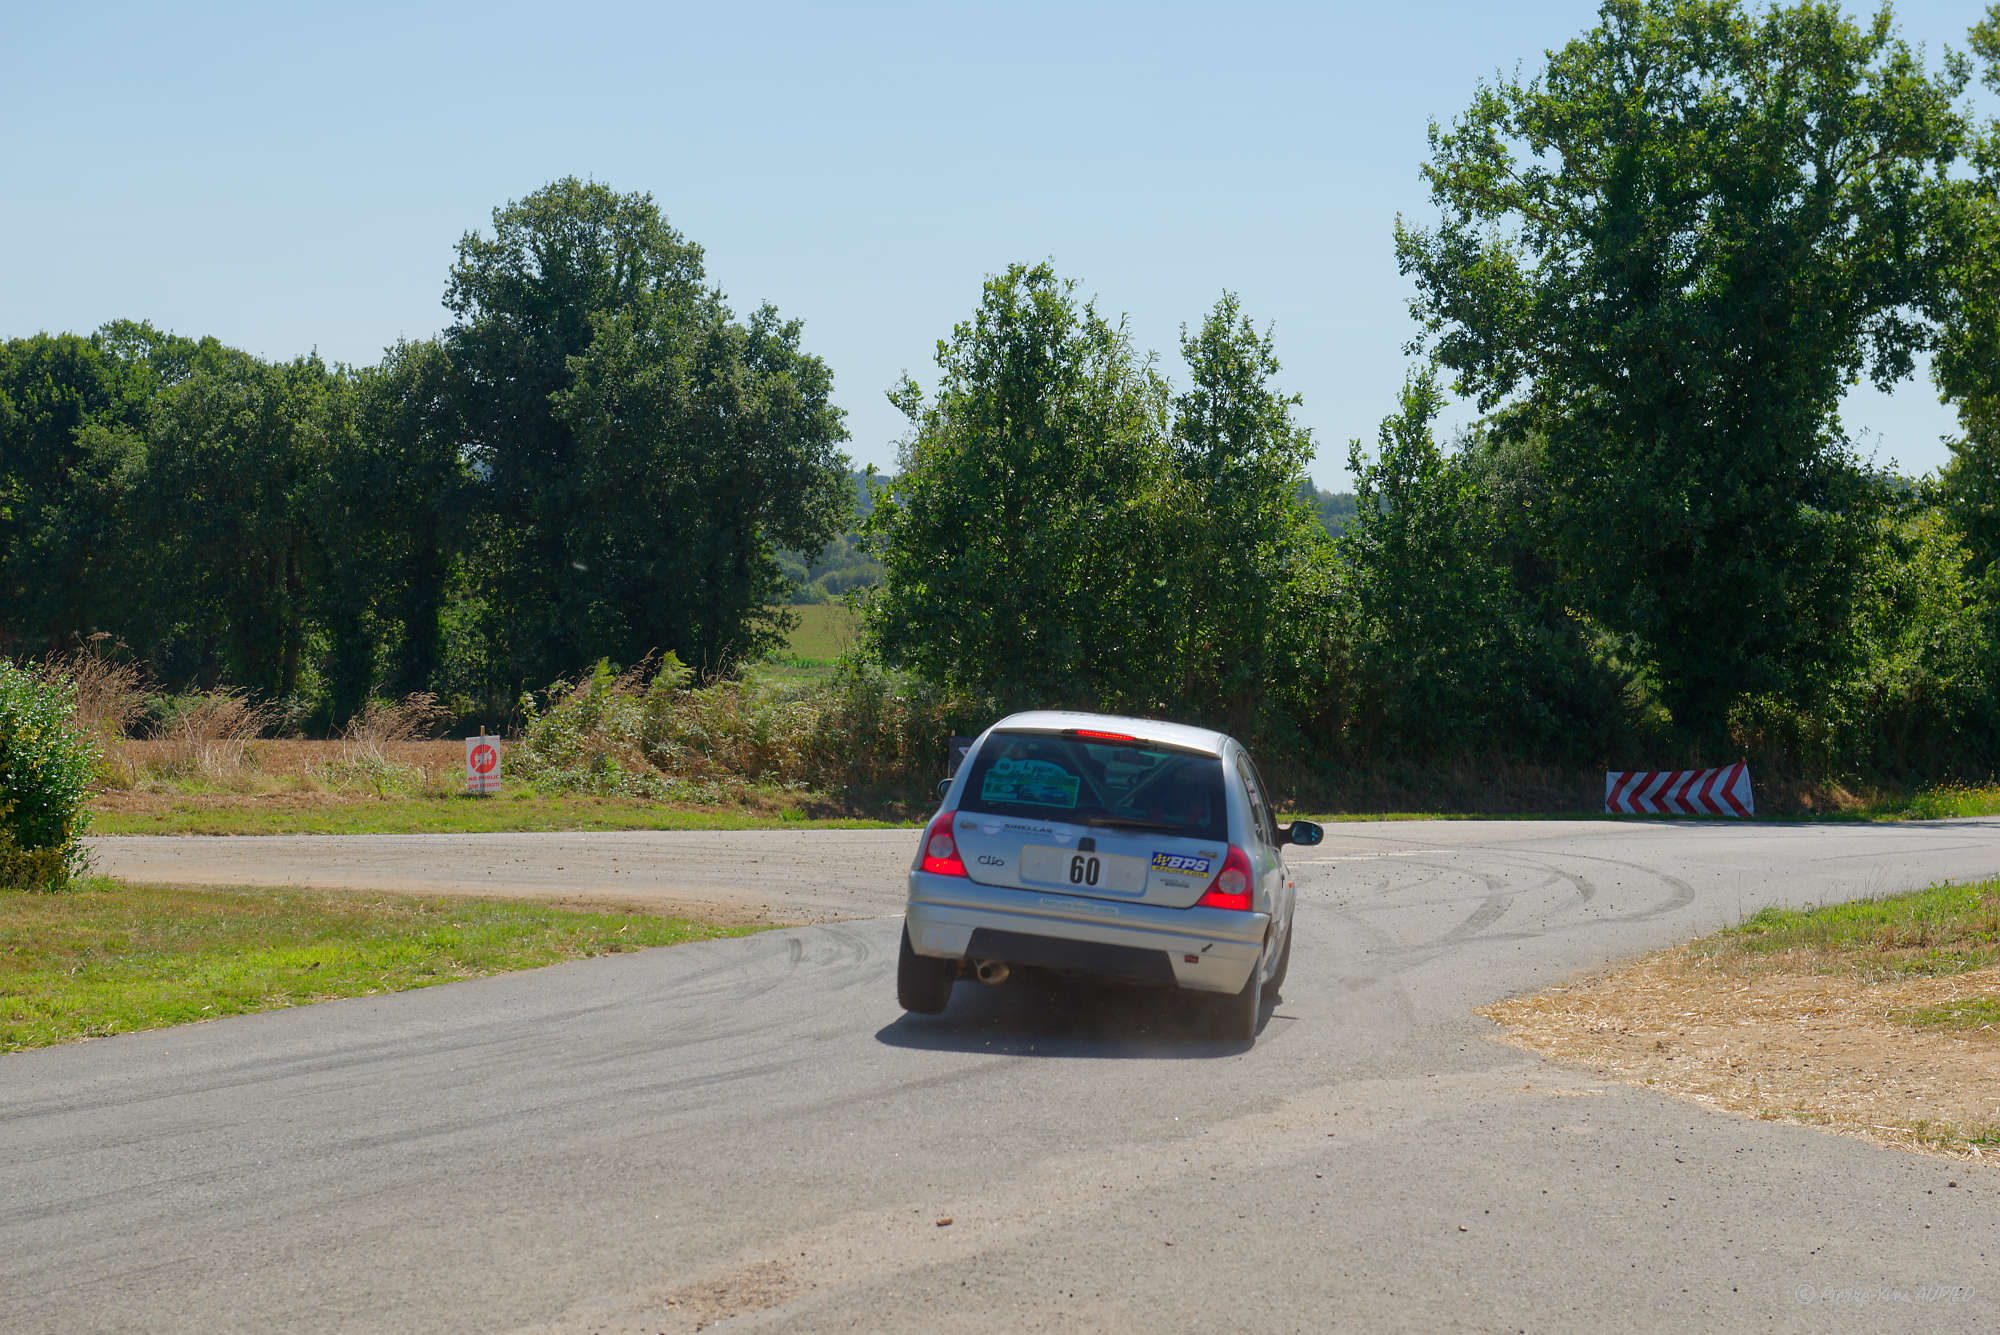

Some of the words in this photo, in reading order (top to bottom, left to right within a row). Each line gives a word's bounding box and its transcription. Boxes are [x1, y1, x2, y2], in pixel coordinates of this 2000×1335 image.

[977, 855, 1005, 867] Clio
[1168, 856, 1208, 871] BPS
[1070, 855, 1100, 886] 60
